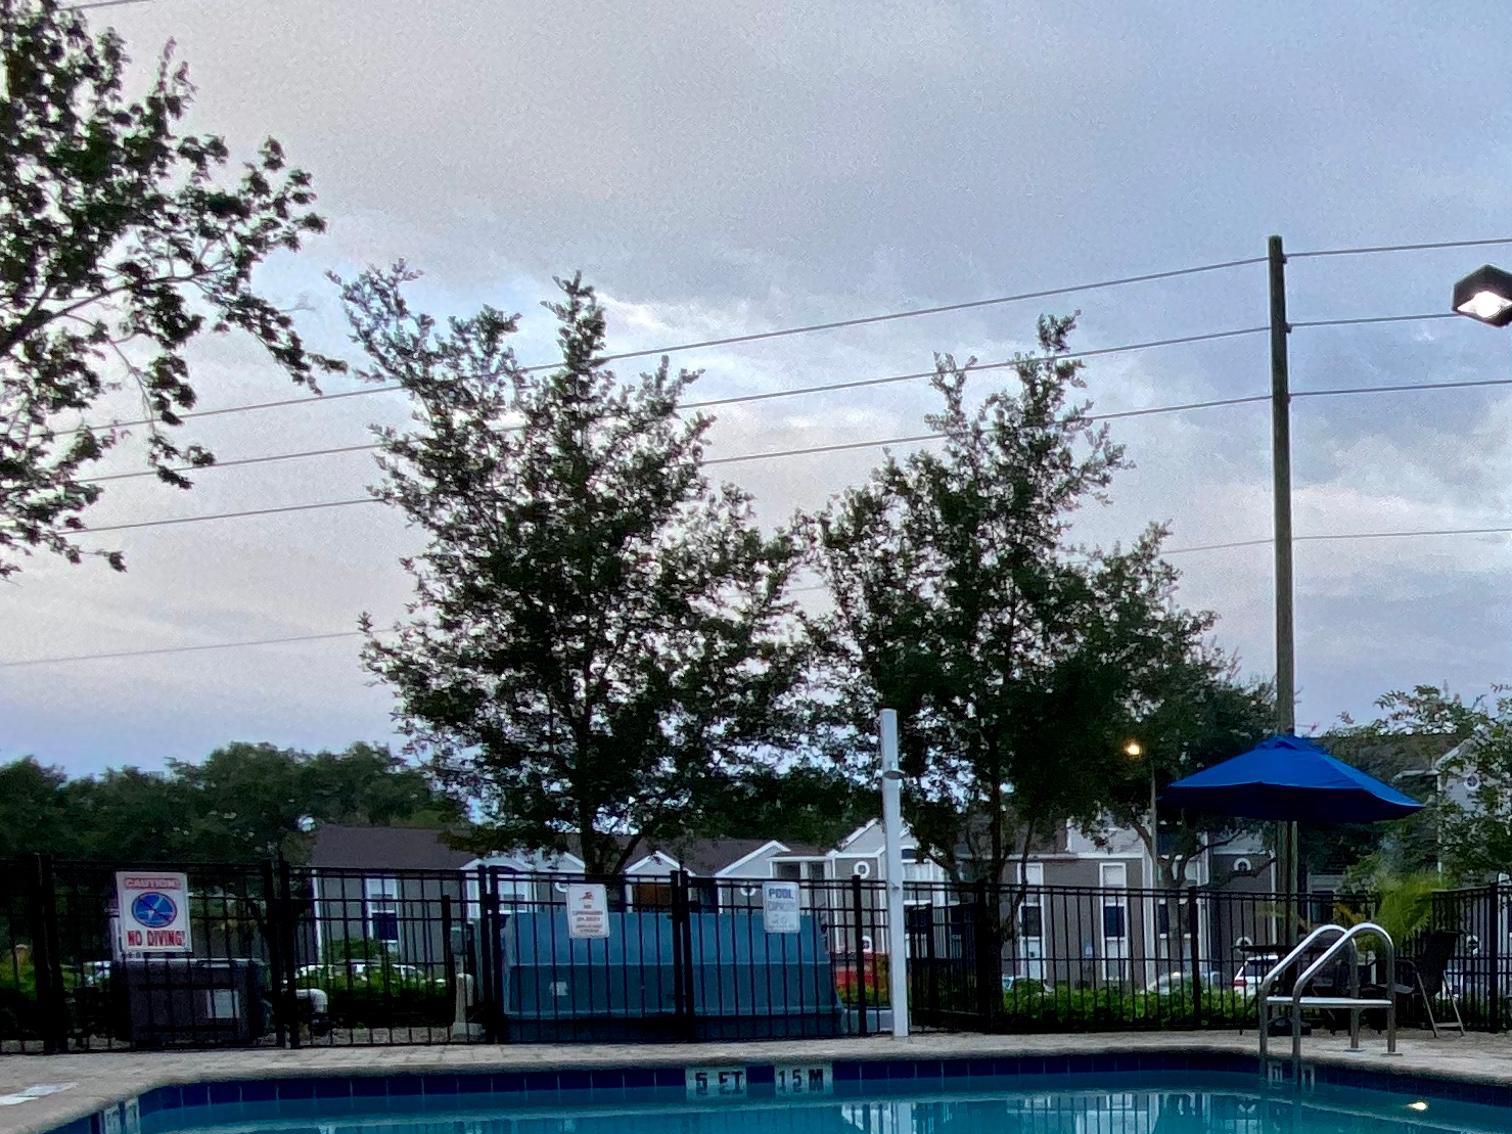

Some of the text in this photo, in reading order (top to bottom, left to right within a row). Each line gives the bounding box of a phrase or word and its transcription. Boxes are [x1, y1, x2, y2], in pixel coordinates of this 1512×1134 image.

[769, 888, 793, 899] POOL
[127, 930, 143, 946] NO
[718, 1071, 744, 1088] FT
